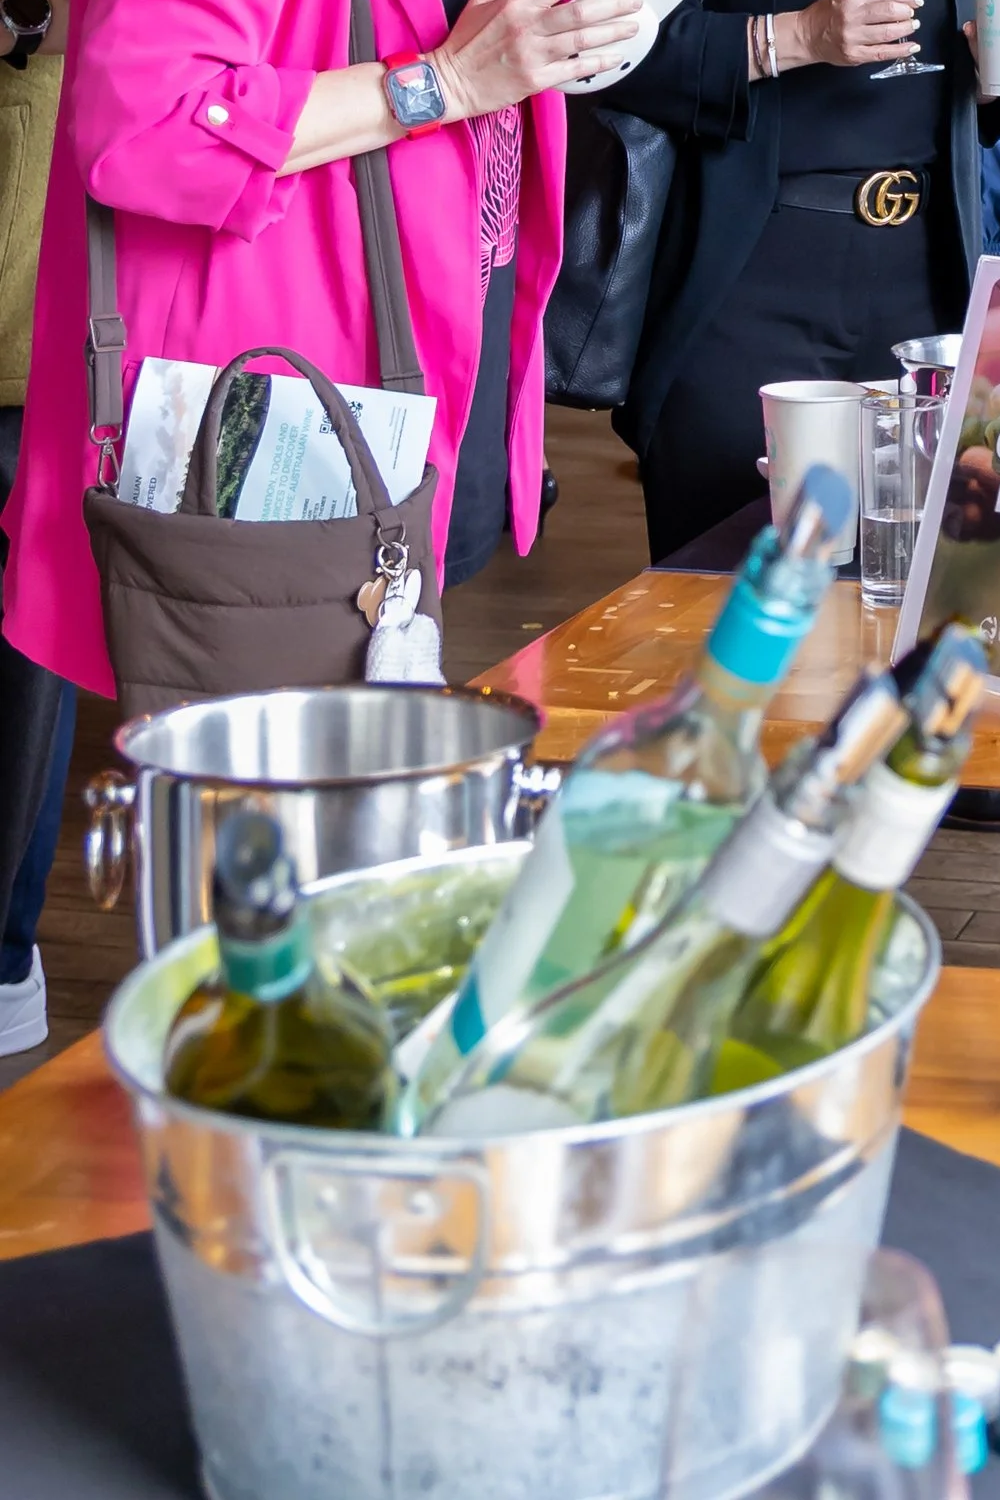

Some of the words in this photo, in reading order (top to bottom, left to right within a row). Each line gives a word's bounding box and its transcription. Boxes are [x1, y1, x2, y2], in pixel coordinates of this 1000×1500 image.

[271, 444, 284, 476] TOOLS
[278, 423, 289, 443] AND
[281, 425, 299, 474] DISCOVER
[289, 433, 308, 492] AUSTRALIAN
[301, 407, 314, 432] WINE
[279, 475, 288, 487] TO
